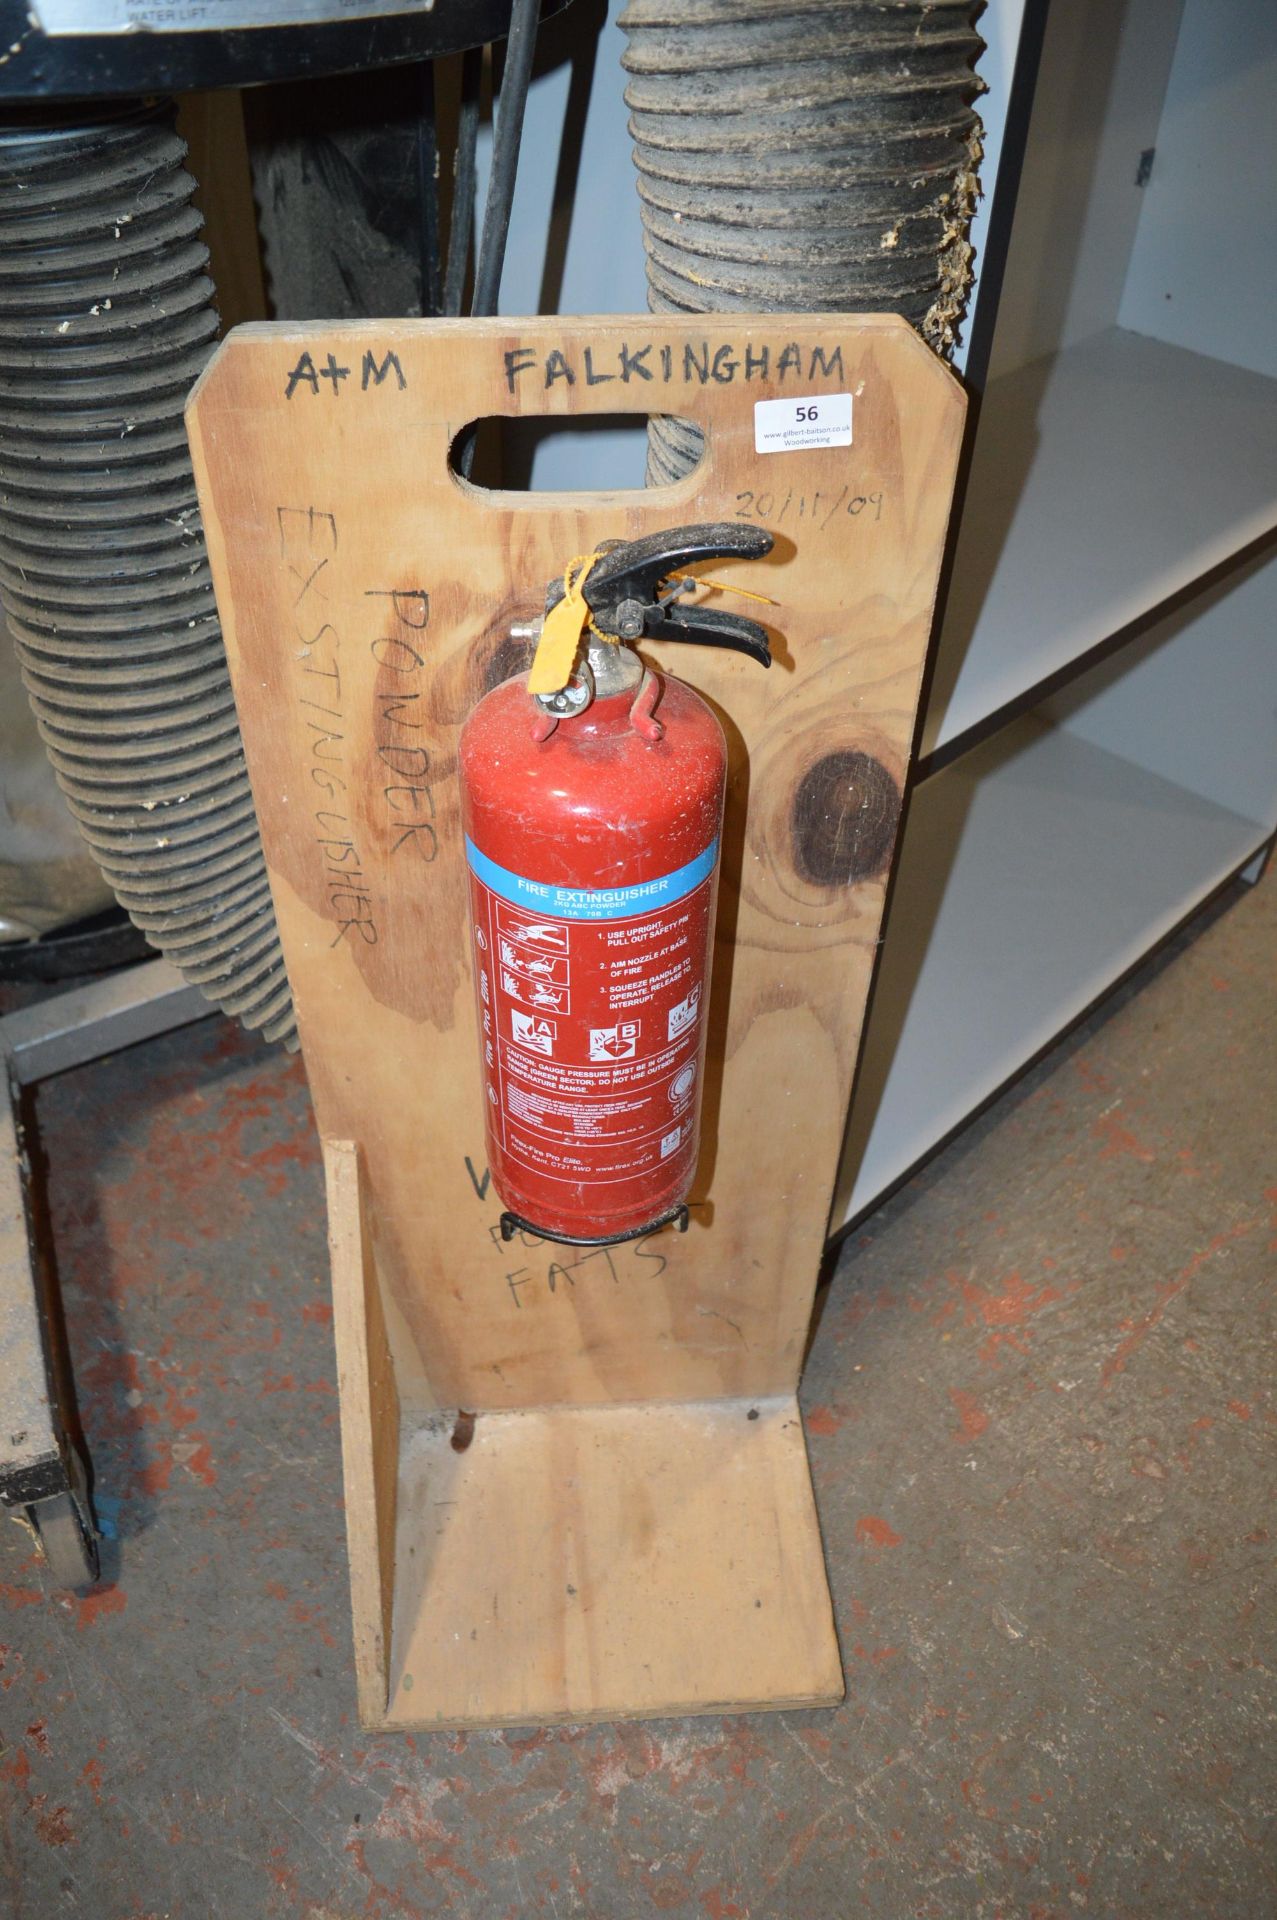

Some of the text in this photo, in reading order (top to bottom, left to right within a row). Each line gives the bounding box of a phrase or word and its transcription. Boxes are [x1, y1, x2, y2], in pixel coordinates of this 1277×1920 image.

[126, 8, 207, 22] WATER LIFT
[504, 341, 846, 394] FALKINGHAM
[795, 406, 819, 422] 56
[763, 425, 851, 439] www.gilbert-baitson.co.uk
[784, 436, 831, 446] Woodworking
[364, 588, 438, 863] POWDER
[518, 879, 669, 902] FIRE EXTINGUISHER
[591, 901, 626, 909] POWDER
[607, 914, 689, 947] PULL OUT SAFETY PIN
[607, 931, 625, 939] USE
[610, 961, 626, 969] AIM
[627, 952, 659, 966] NOZZLE
[660, 947, 669, 957] AT
[670, 936, 688, 952] BASE
[609, 979, 648, 993] SQUEEZE
[682, 957, 691, 967] TO
[610, 966, 642, 977] OF FIRE
[651, 971, 682, 991] RELEASE
[683, 965, 692, 975] TO
[609, 994, 655, 1009] INTERRUPT
[483, 1008, 491, 1036] Pro
[537, 1020, 552, 1036] A
[621, 1023, 637, 1037] B
[538, 1063, 566, 1075] GAUGE
[568, 1070, 610, 1078] PRESSURE
[612, 1067, 634, 1076] MUST
[636, 1063, 647, 1071] BE
[656, 1037, 690, 1063] OPERATING
[506, 1054, 528, 1071] RANGE
[530, 1067, 558, 1081] (GREEN
[630, 1072, 645, 1080] USE
[647, 1057, 675, 1075] OUTSIDE
[507, 1061, 557, 1088] TEMPERATURE
[545, 1152, 561, 1161] Pro
[550, 1161, 570, 1170] CT21
